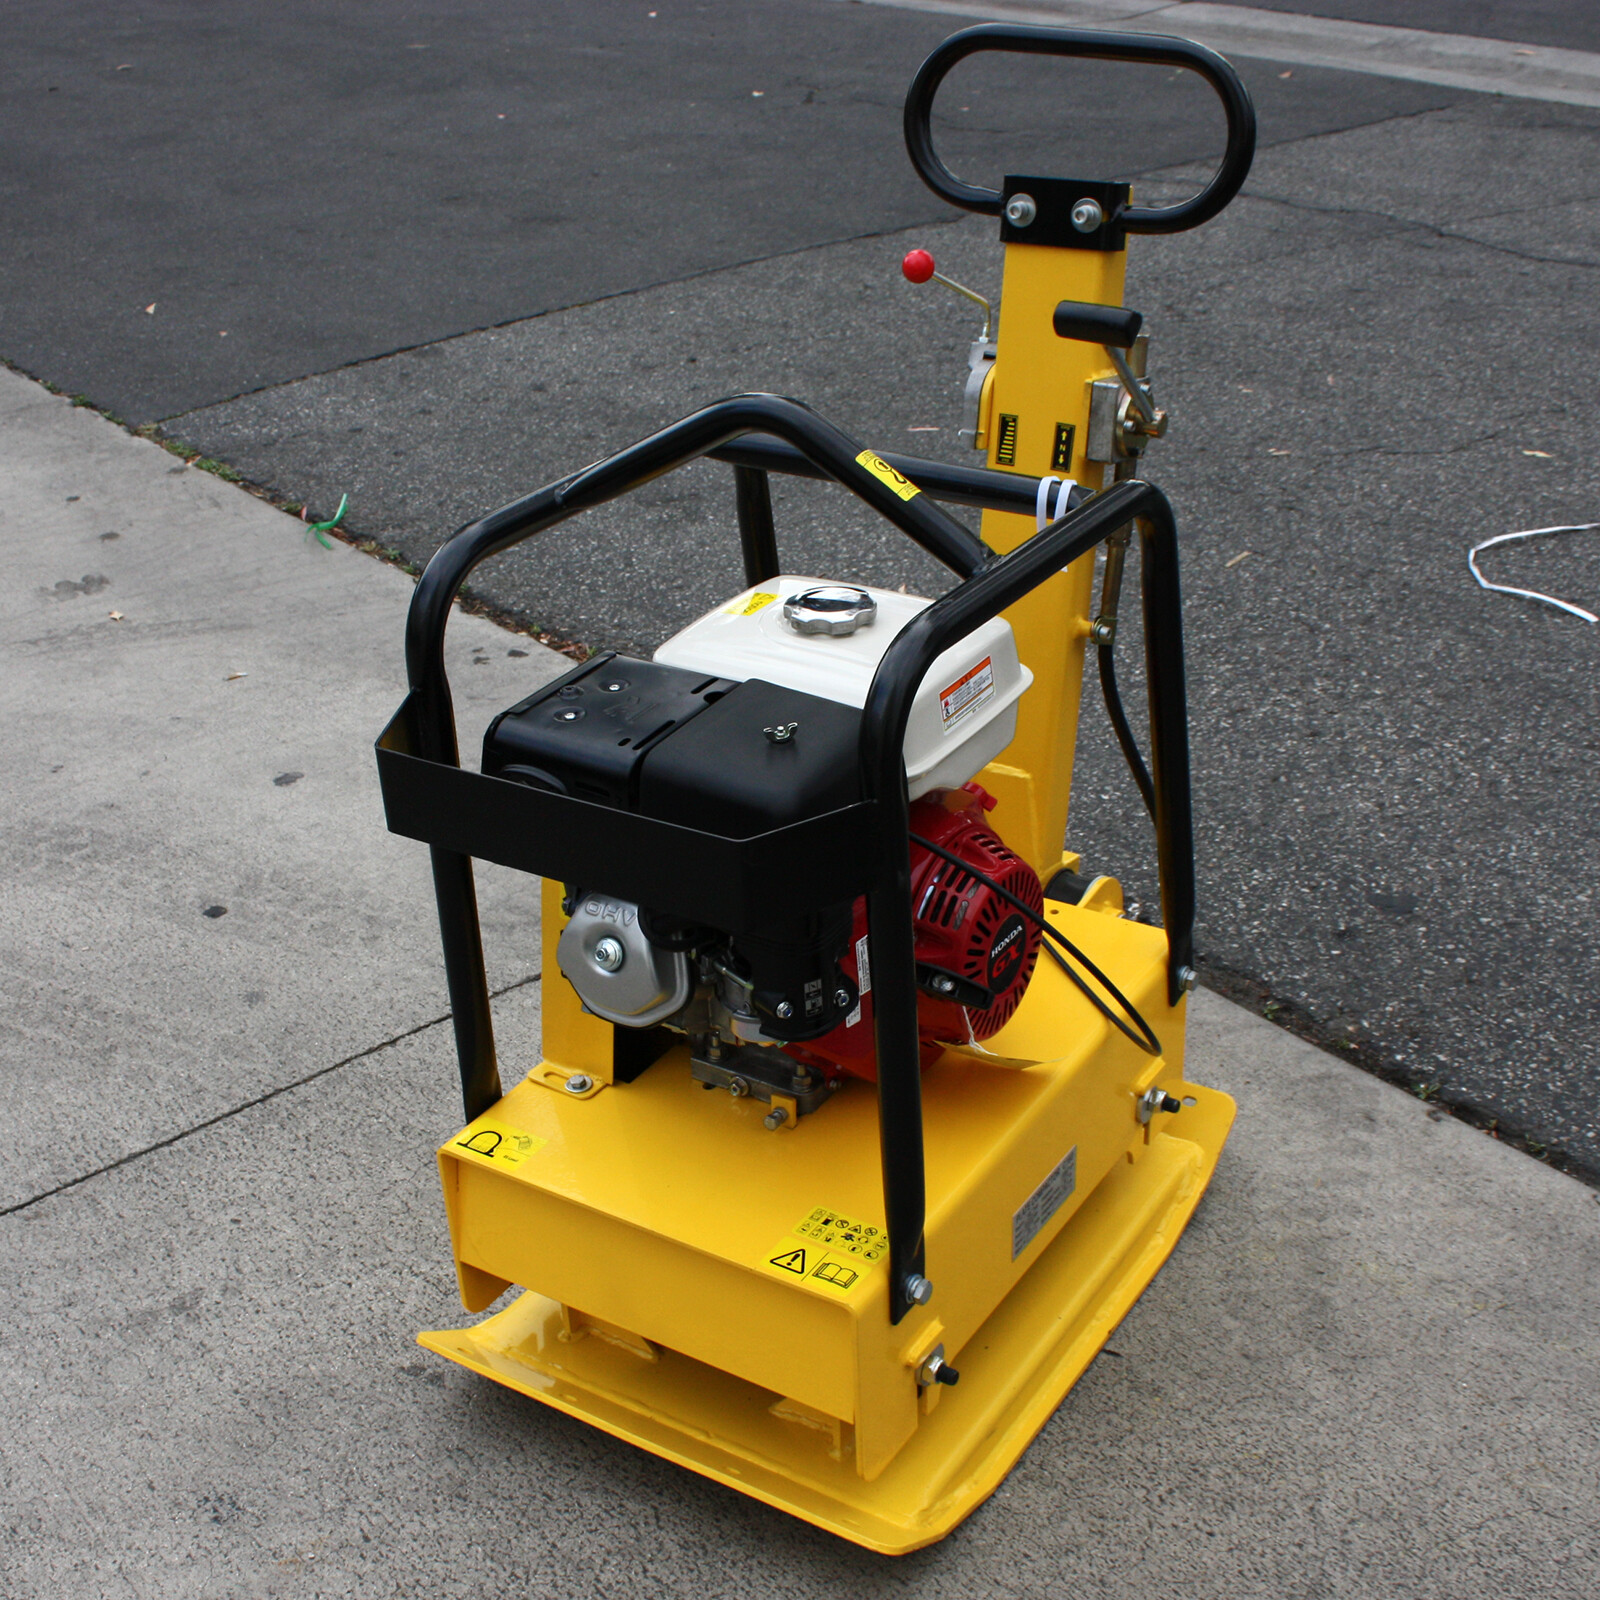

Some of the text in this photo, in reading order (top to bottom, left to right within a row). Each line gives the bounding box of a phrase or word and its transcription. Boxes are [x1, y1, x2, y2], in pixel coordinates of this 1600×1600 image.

[585, 901, 637, 927] OHV
[991, 925, 1022, 958] HONDA
[992, 938, 1021, 978] GX
